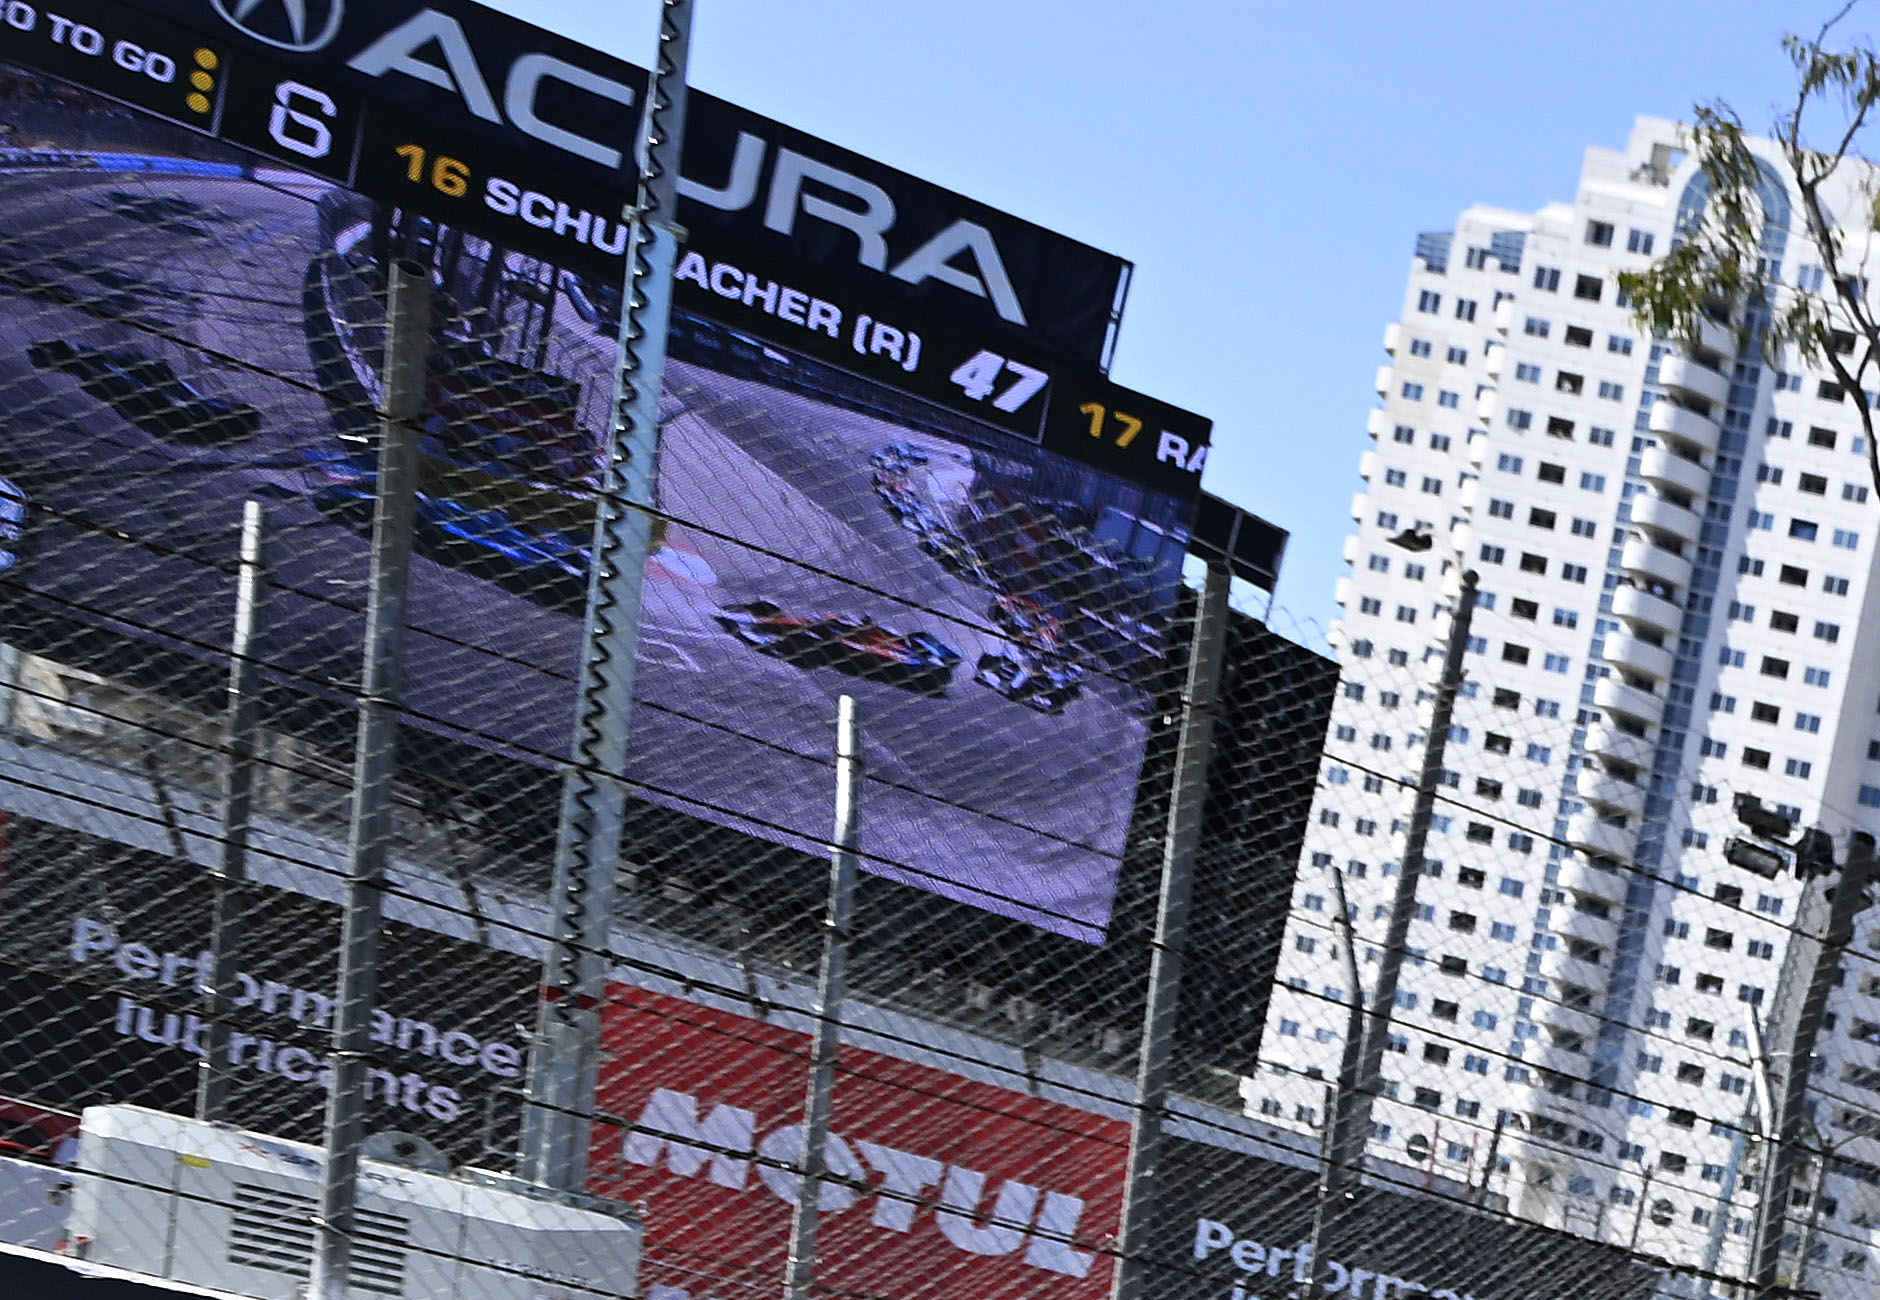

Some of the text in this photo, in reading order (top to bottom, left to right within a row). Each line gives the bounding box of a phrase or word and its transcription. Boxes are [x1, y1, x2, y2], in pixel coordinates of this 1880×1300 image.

[46, 12, 105, 56] TO
[112, 40, 176, 83] GO
[268, 80, 338, 158] 6
[348, 8, 1029, 328] ACURA
[395, 144, 1050, 415] 16 SCHUACHER (R) 47
[1080, 402, 1143, 447] 17
[622, 1087, 1096, 1280] MOTUL
